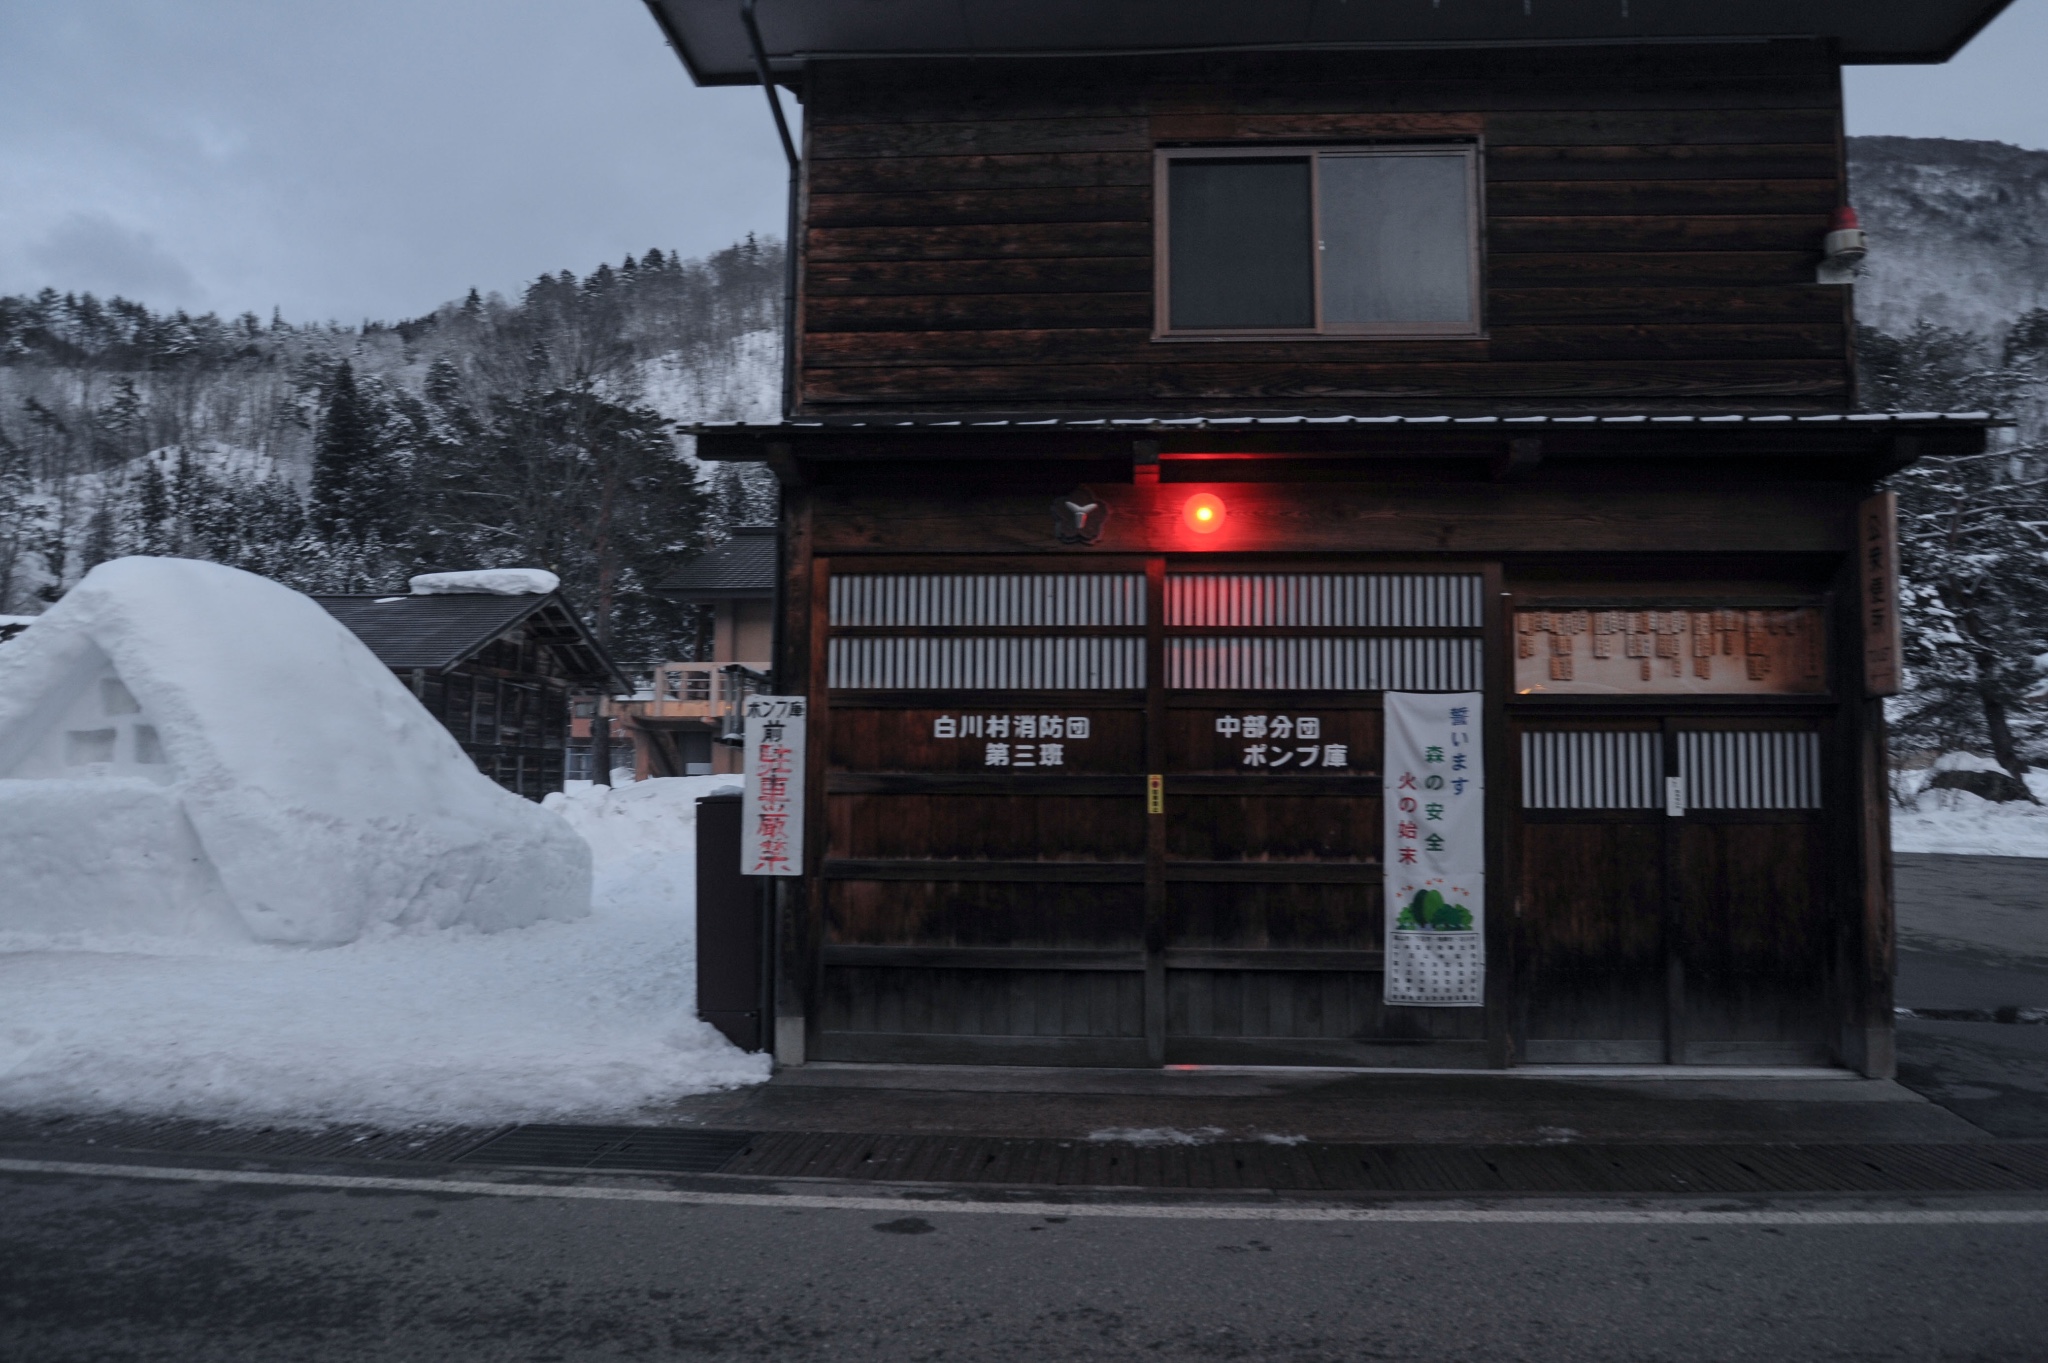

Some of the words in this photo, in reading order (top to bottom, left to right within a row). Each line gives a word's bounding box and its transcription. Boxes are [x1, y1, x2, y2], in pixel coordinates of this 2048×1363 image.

[933, 715, 1090, 739] 白川村消防団
[985, 743, 1065, 767] 第三班
[1215, 715, 1321, 739] 中部分団
[1450, 706, 1469, 796] 誓います
[1398, 771, 1418, 865] 火の始末
[1425, 745, 1446, 852] 森の安全
